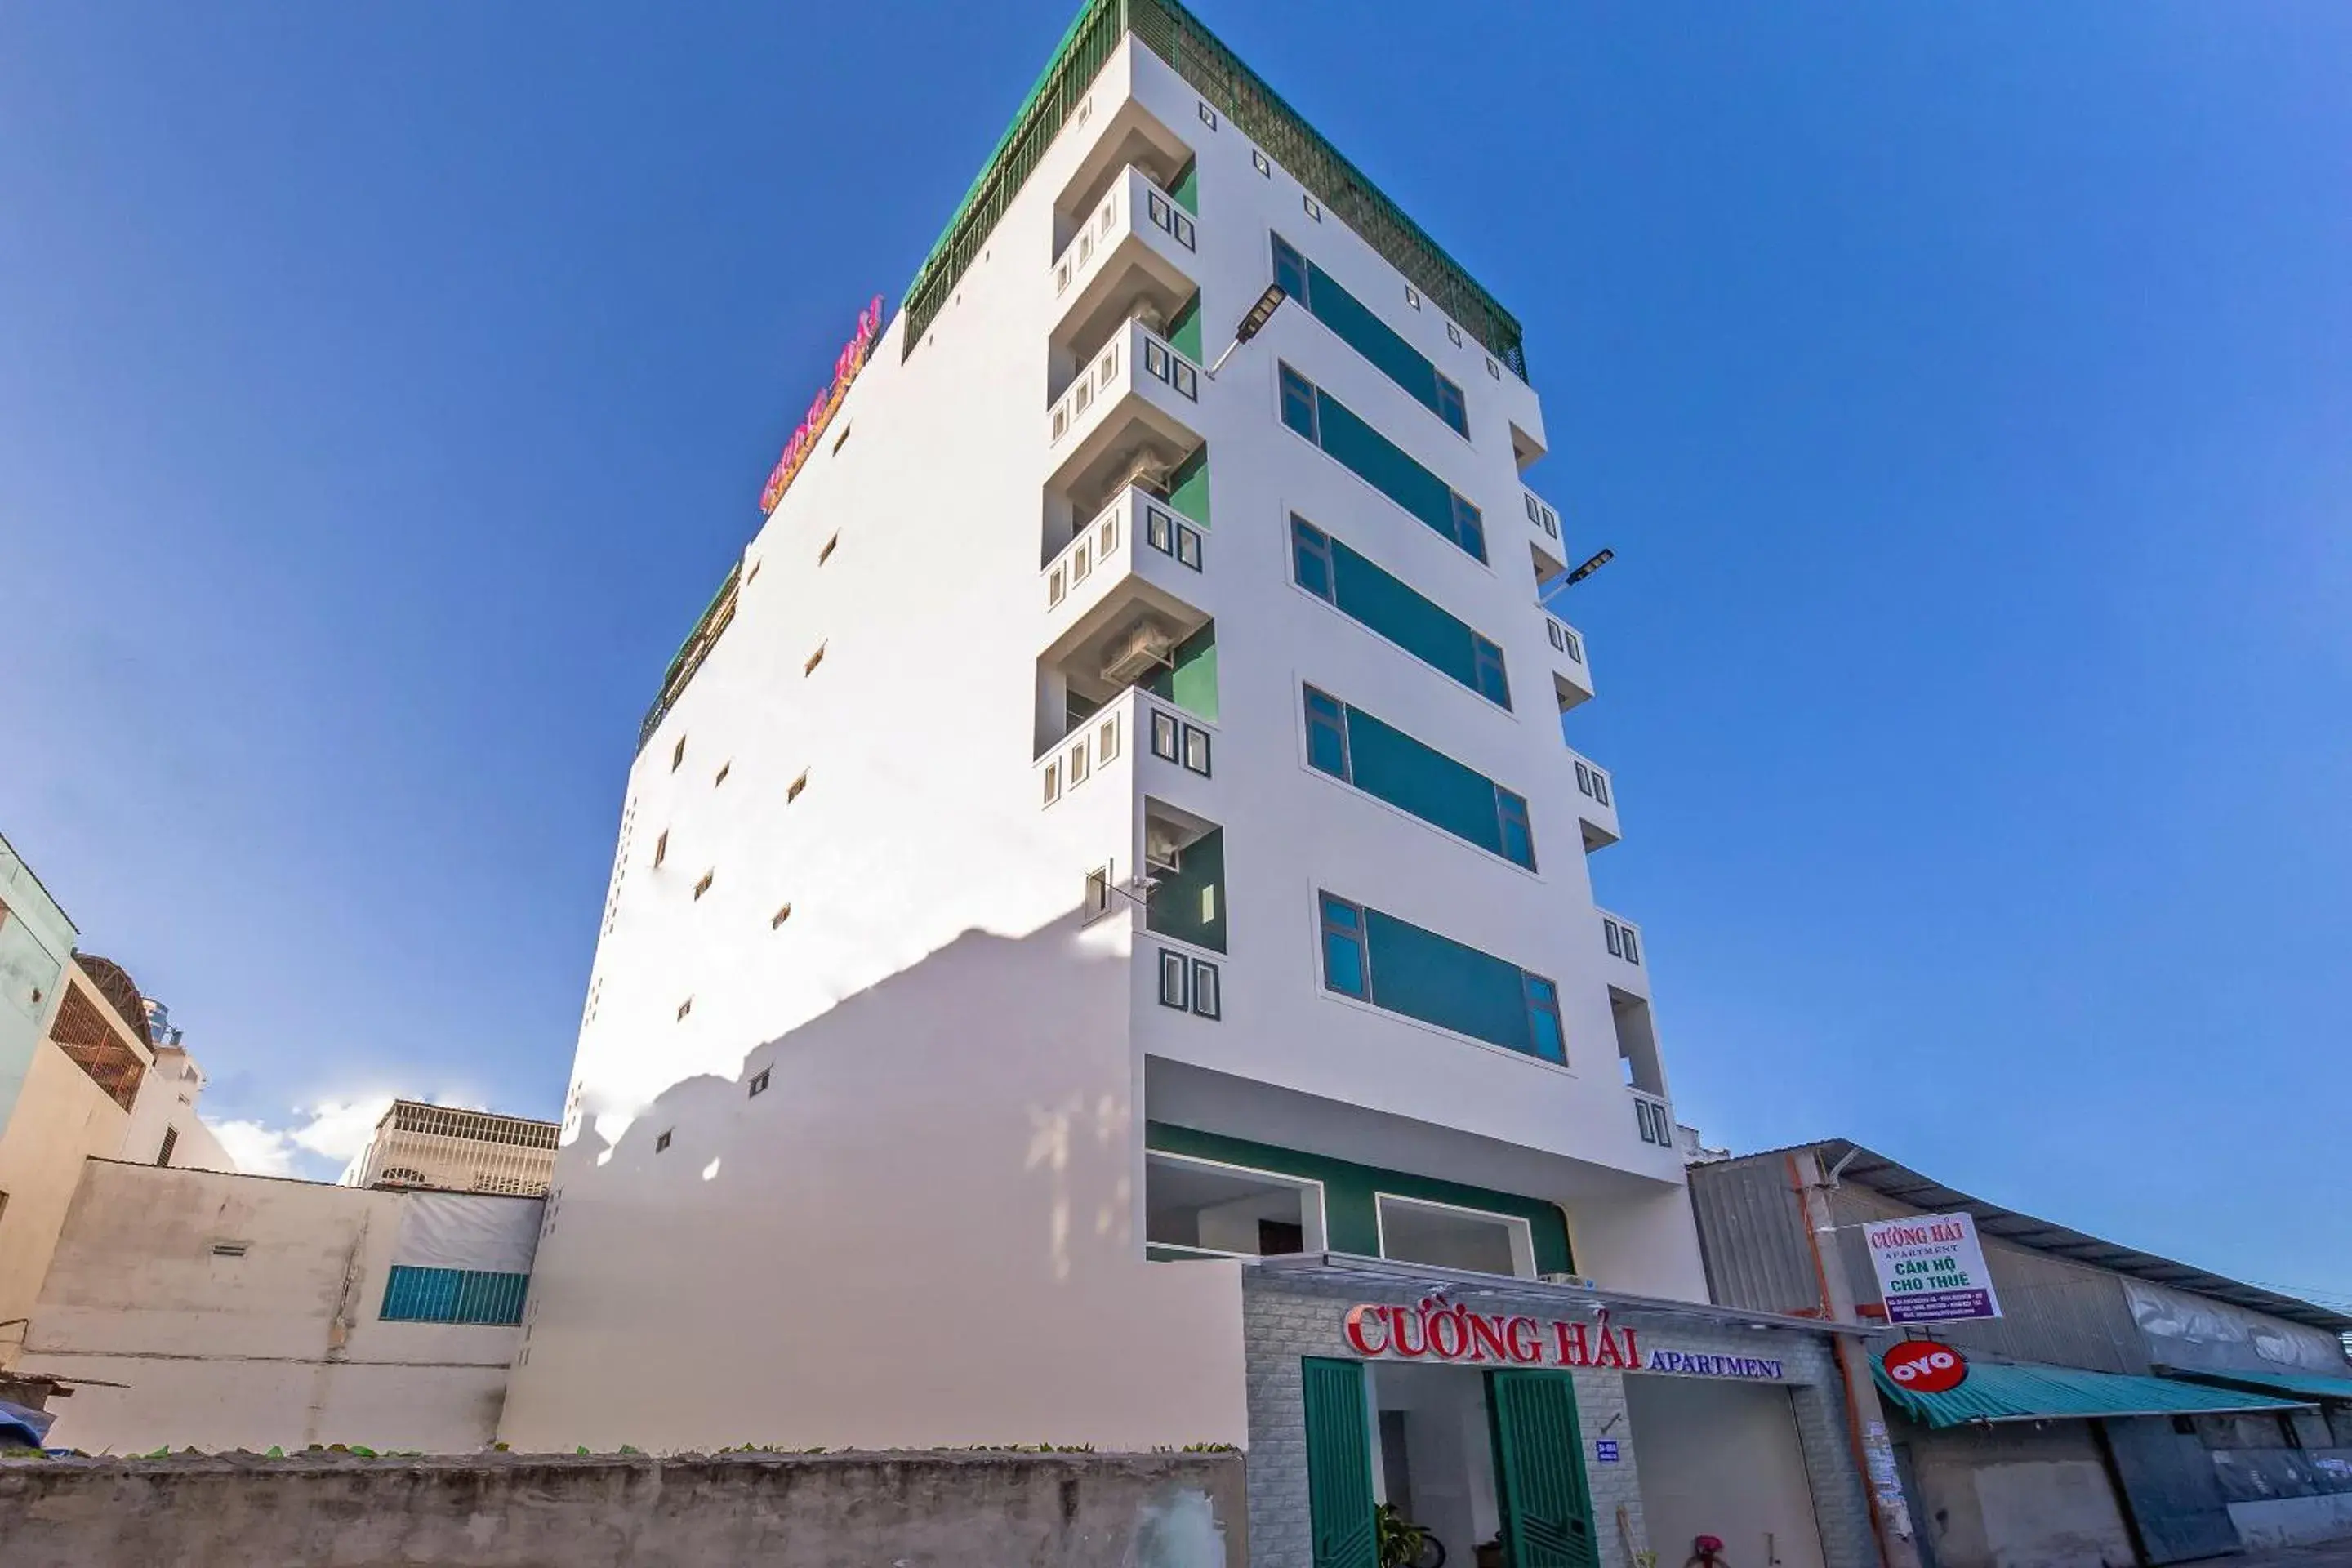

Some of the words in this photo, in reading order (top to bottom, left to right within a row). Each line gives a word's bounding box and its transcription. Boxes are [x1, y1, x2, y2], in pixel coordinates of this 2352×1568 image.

[1884, 1245, 1959, 1259] APARTMENT
[1895, 1260, 1929, 1276] CĂN
[1933, 1258, 1956, 1273] HỘ
[1891, 1277, 1922, 1292] CHO
[1927, 1271, 1970, 1289] THUÊ
[1344, 1294, 1542, 1362] CƯỜNG
[1552, 1307, 1642, 1370] HẢI
[1648, 1349, 1784, 1380] APARTMENT
[1892, 1352, 1954, 1381] OYO
